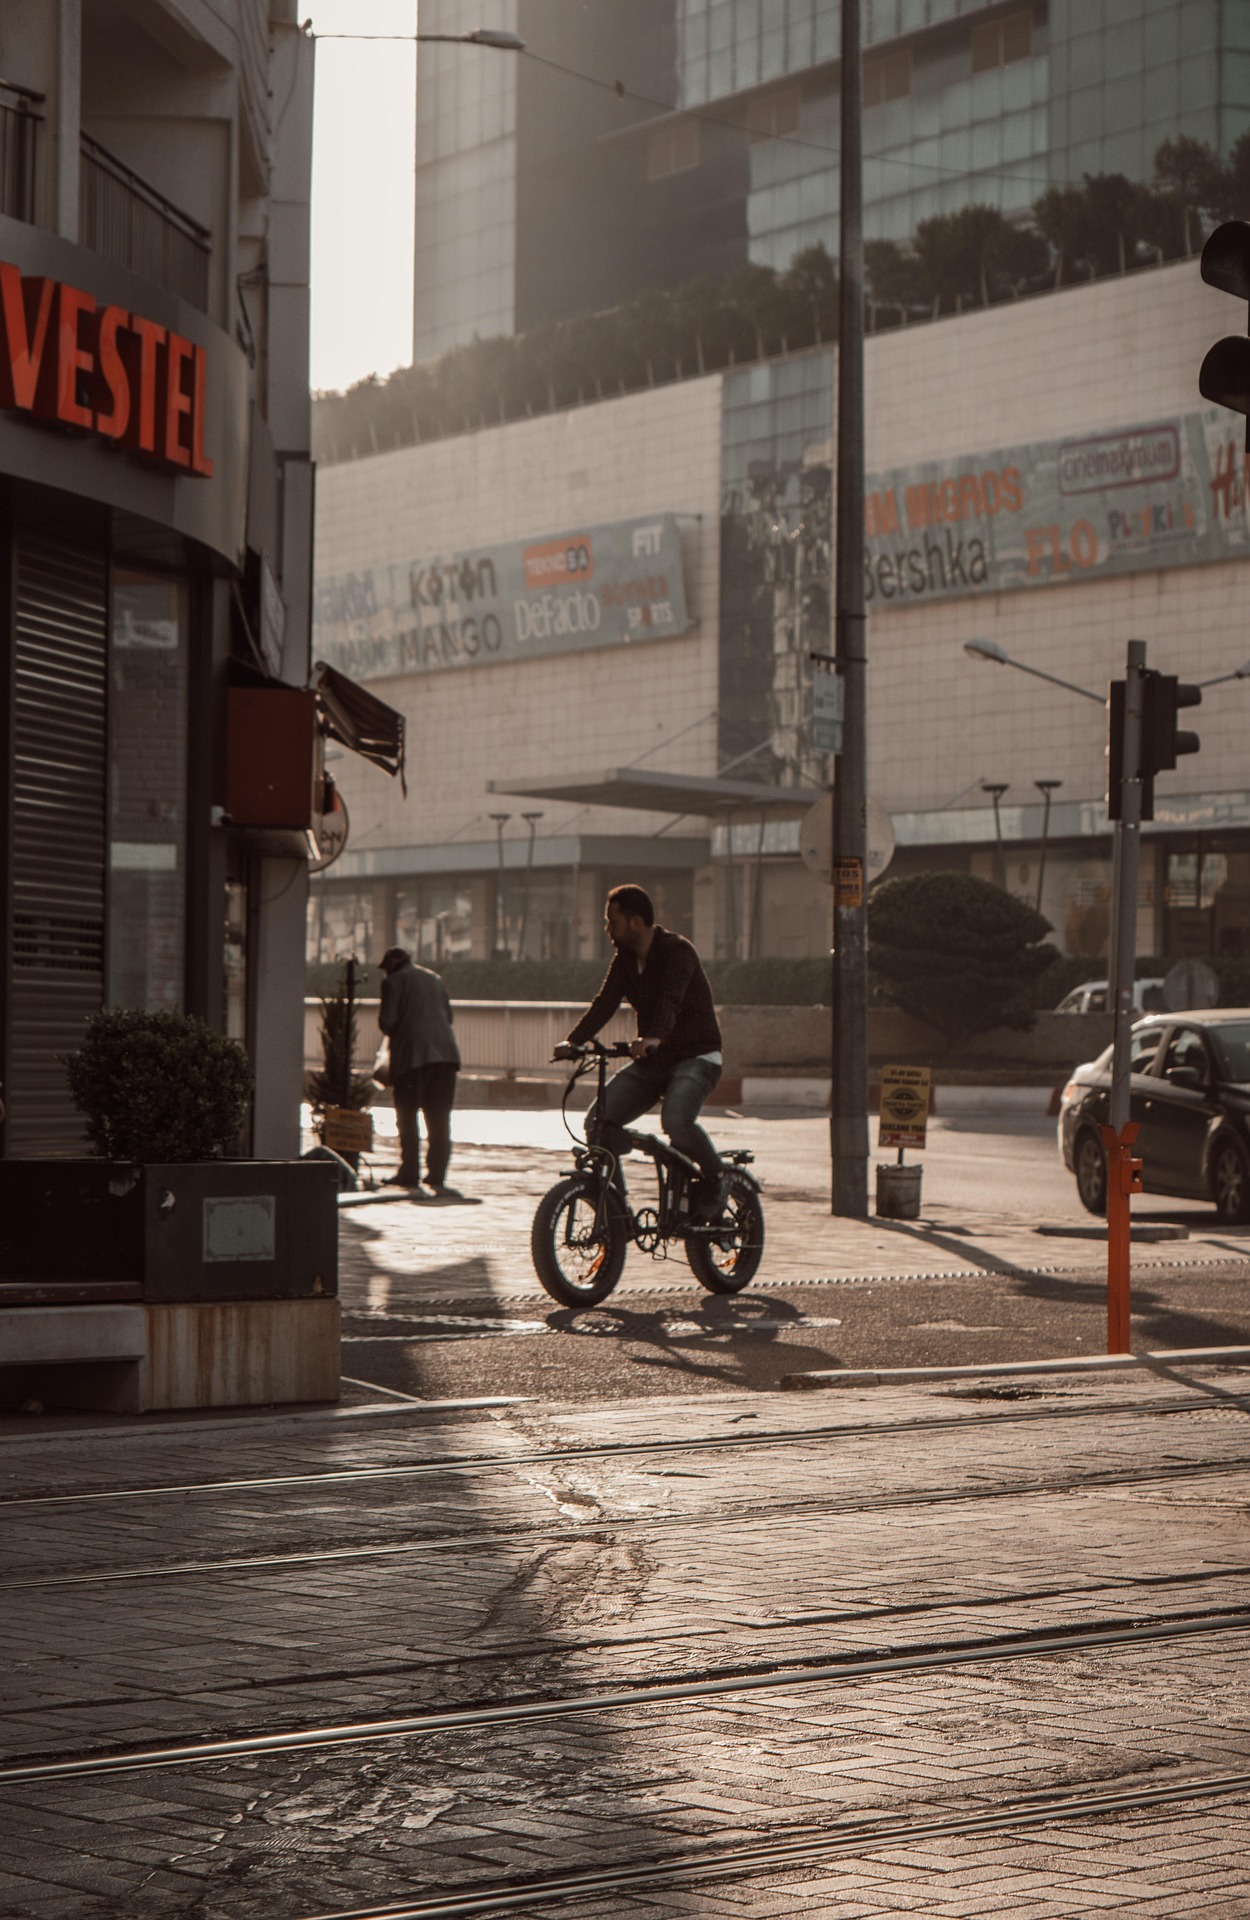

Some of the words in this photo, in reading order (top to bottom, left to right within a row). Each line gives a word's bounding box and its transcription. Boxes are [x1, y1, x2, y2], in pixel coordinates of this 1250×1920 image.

[0, 262, 214, 479] VESTEL
[632, 525, 663, 557] FIT
[864, 527, 989, 601] Bershka
[1023, 518, 1099, 577] FLO
[399, 614, 503, 668] MANGO
[513, 590, 601, 641] DeFacto
